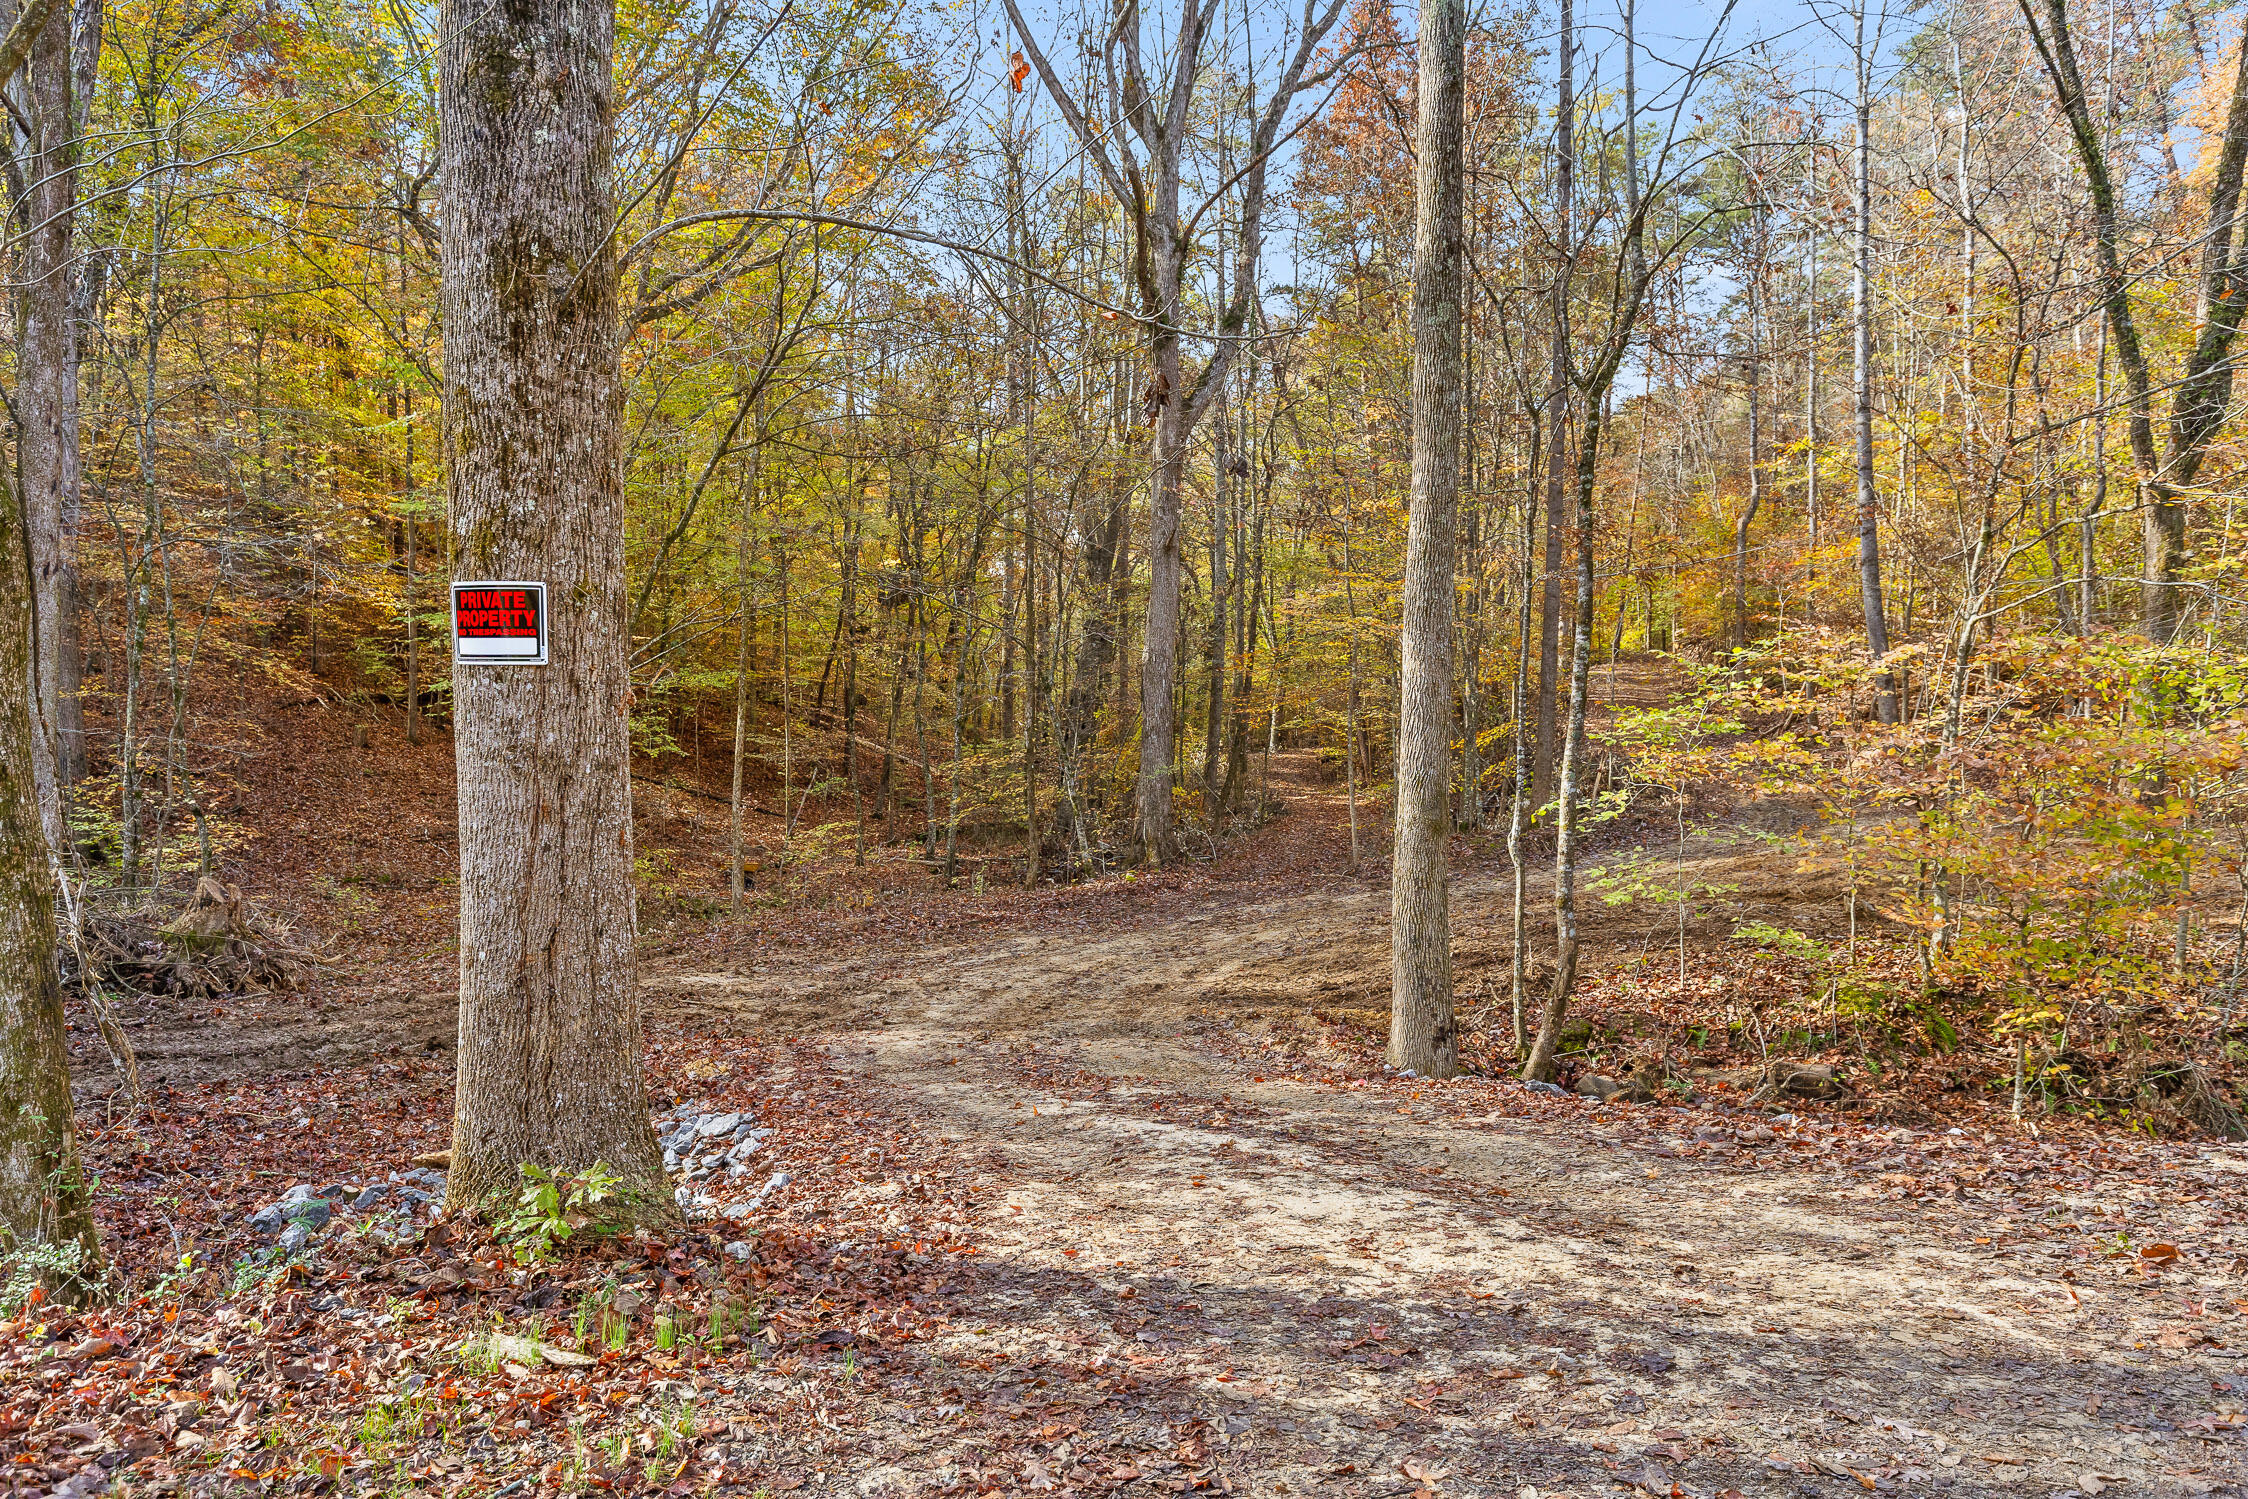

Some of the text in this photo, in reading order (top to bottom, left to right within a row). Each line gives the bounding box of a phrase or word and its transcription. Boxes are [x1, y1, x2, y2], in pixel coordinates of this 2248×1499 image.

[460, 591, 526, 608] PRIVATE
[456, 610, 536, 627] PROPERTY
[458, 628, 537, 636] NO TRESPASSING
